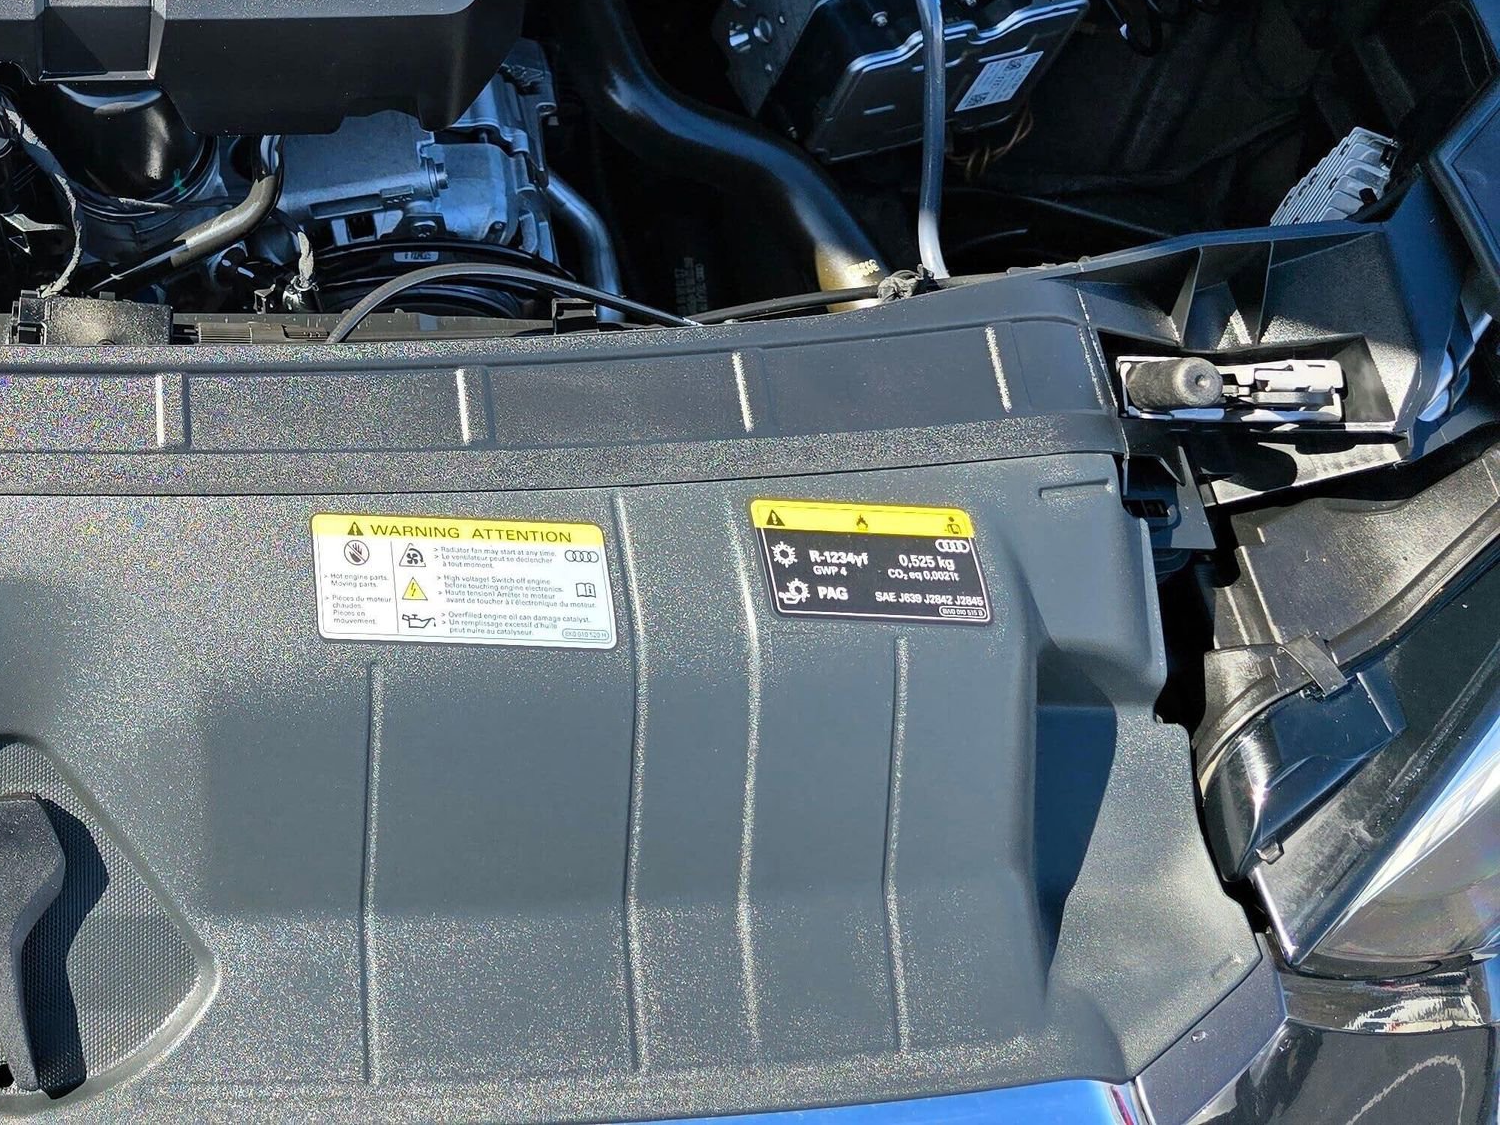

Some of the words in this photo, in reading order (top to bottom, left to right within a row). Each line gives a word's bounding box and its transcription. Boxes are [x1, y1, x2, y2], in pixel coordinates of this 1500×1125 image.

[370, 524, 460, 539] WARNING
[472, 528, 572, 543] ATTENTION
[809, 549, 869, 569] R-1234yf
[898, 554, 936, 569] 0,525
[937, 556, 955, 571] kg
[813, 565, 839, 576] GWP
[840, 566, 848, 577] 4
[909, 571, 923, 582] eq
[330, 580, 357, 588] Moving
[443, 576, 459, 584] High
[491, 576, 515, 584] Switch
[468, 583, 499, 591] touching
[817, 586, 849, 601] PAG
[874, 591, 897, 602] SAE
[898, 592, 922, 604] J639
[923, 593, 953, 605] J2842
[954, 595, 984, 606] J2845
[448, 611, 482, 619] Overfilled
[484, 613, 507, 621] engine
[533, 615, 561, 623] damage
[461, 620, 503, 628] remplissage
